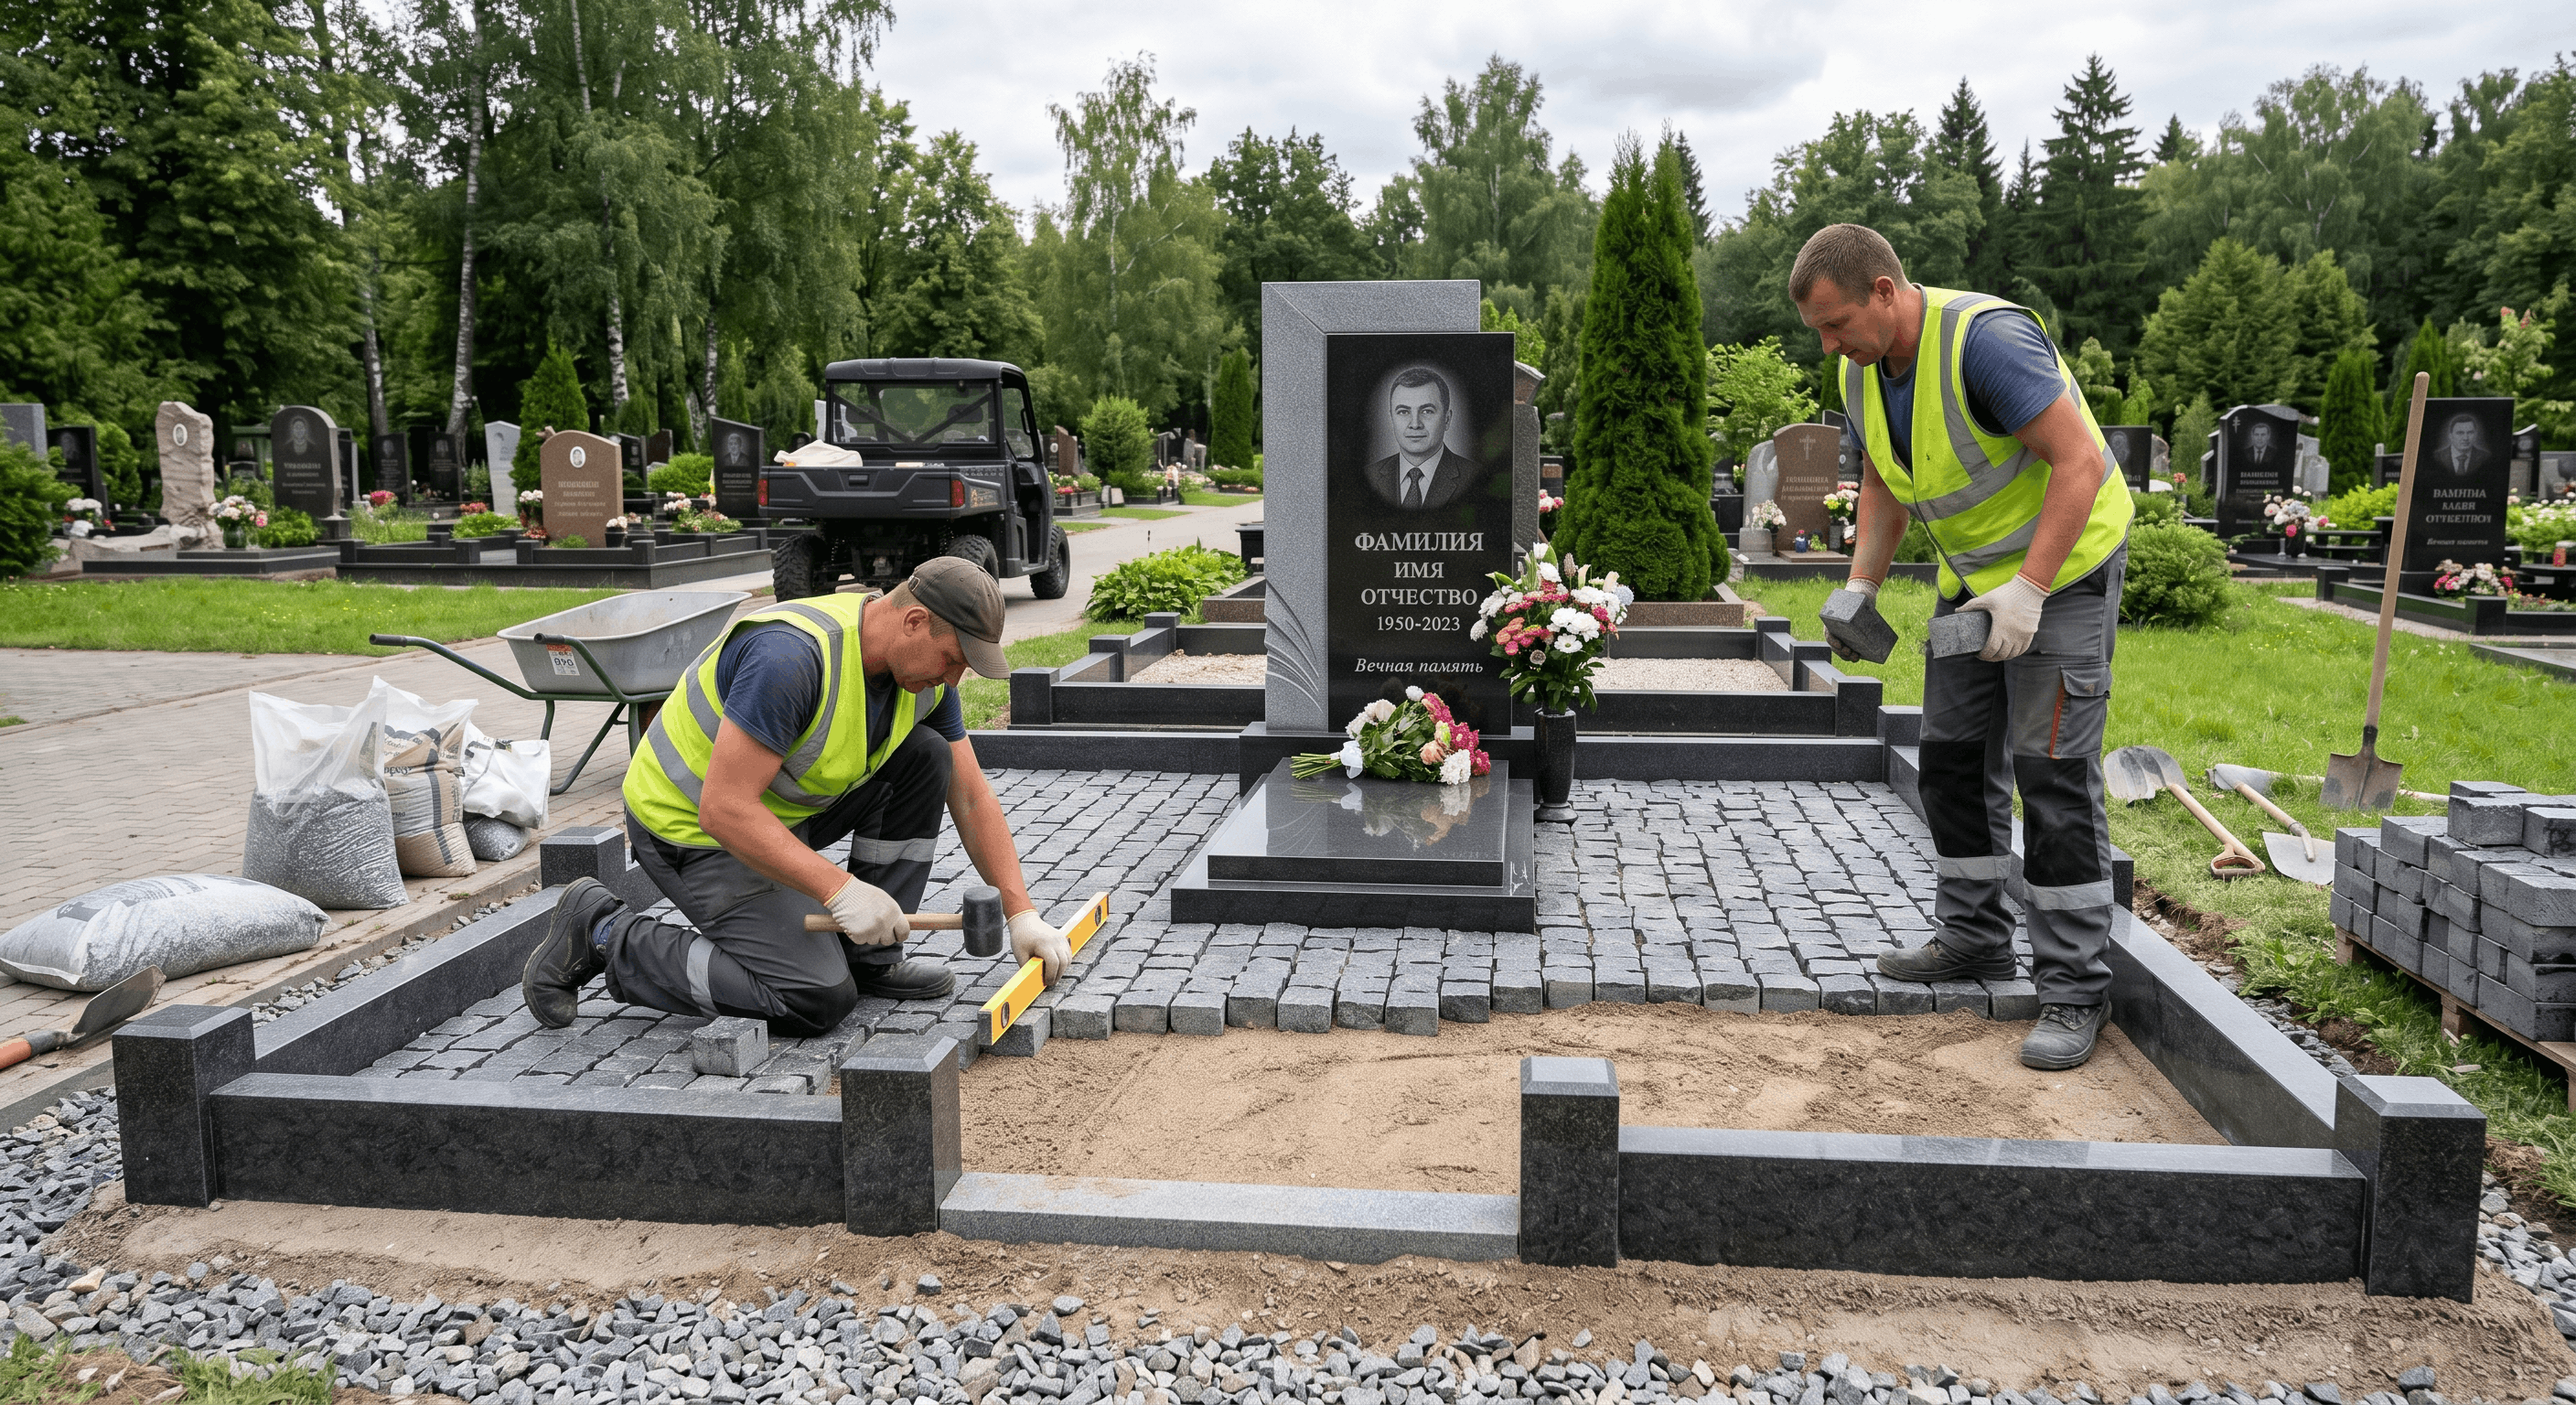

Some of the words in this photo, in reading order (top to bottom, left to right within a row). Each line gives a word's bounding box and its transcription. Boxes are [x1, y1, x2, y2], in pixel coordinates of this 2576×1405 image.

[1355, 532, 1484, 552] ФАМИЛИЯ
[1394, 562, 1444, 578] ИМЯ
[1361, 588, 1477, 606] ОТЧЕСТВО
[1378, 616, 1460, 631] 1950-2023
[1354, 658, 1414, 672] Вечная
[1419, 661, 1484, 672] память
